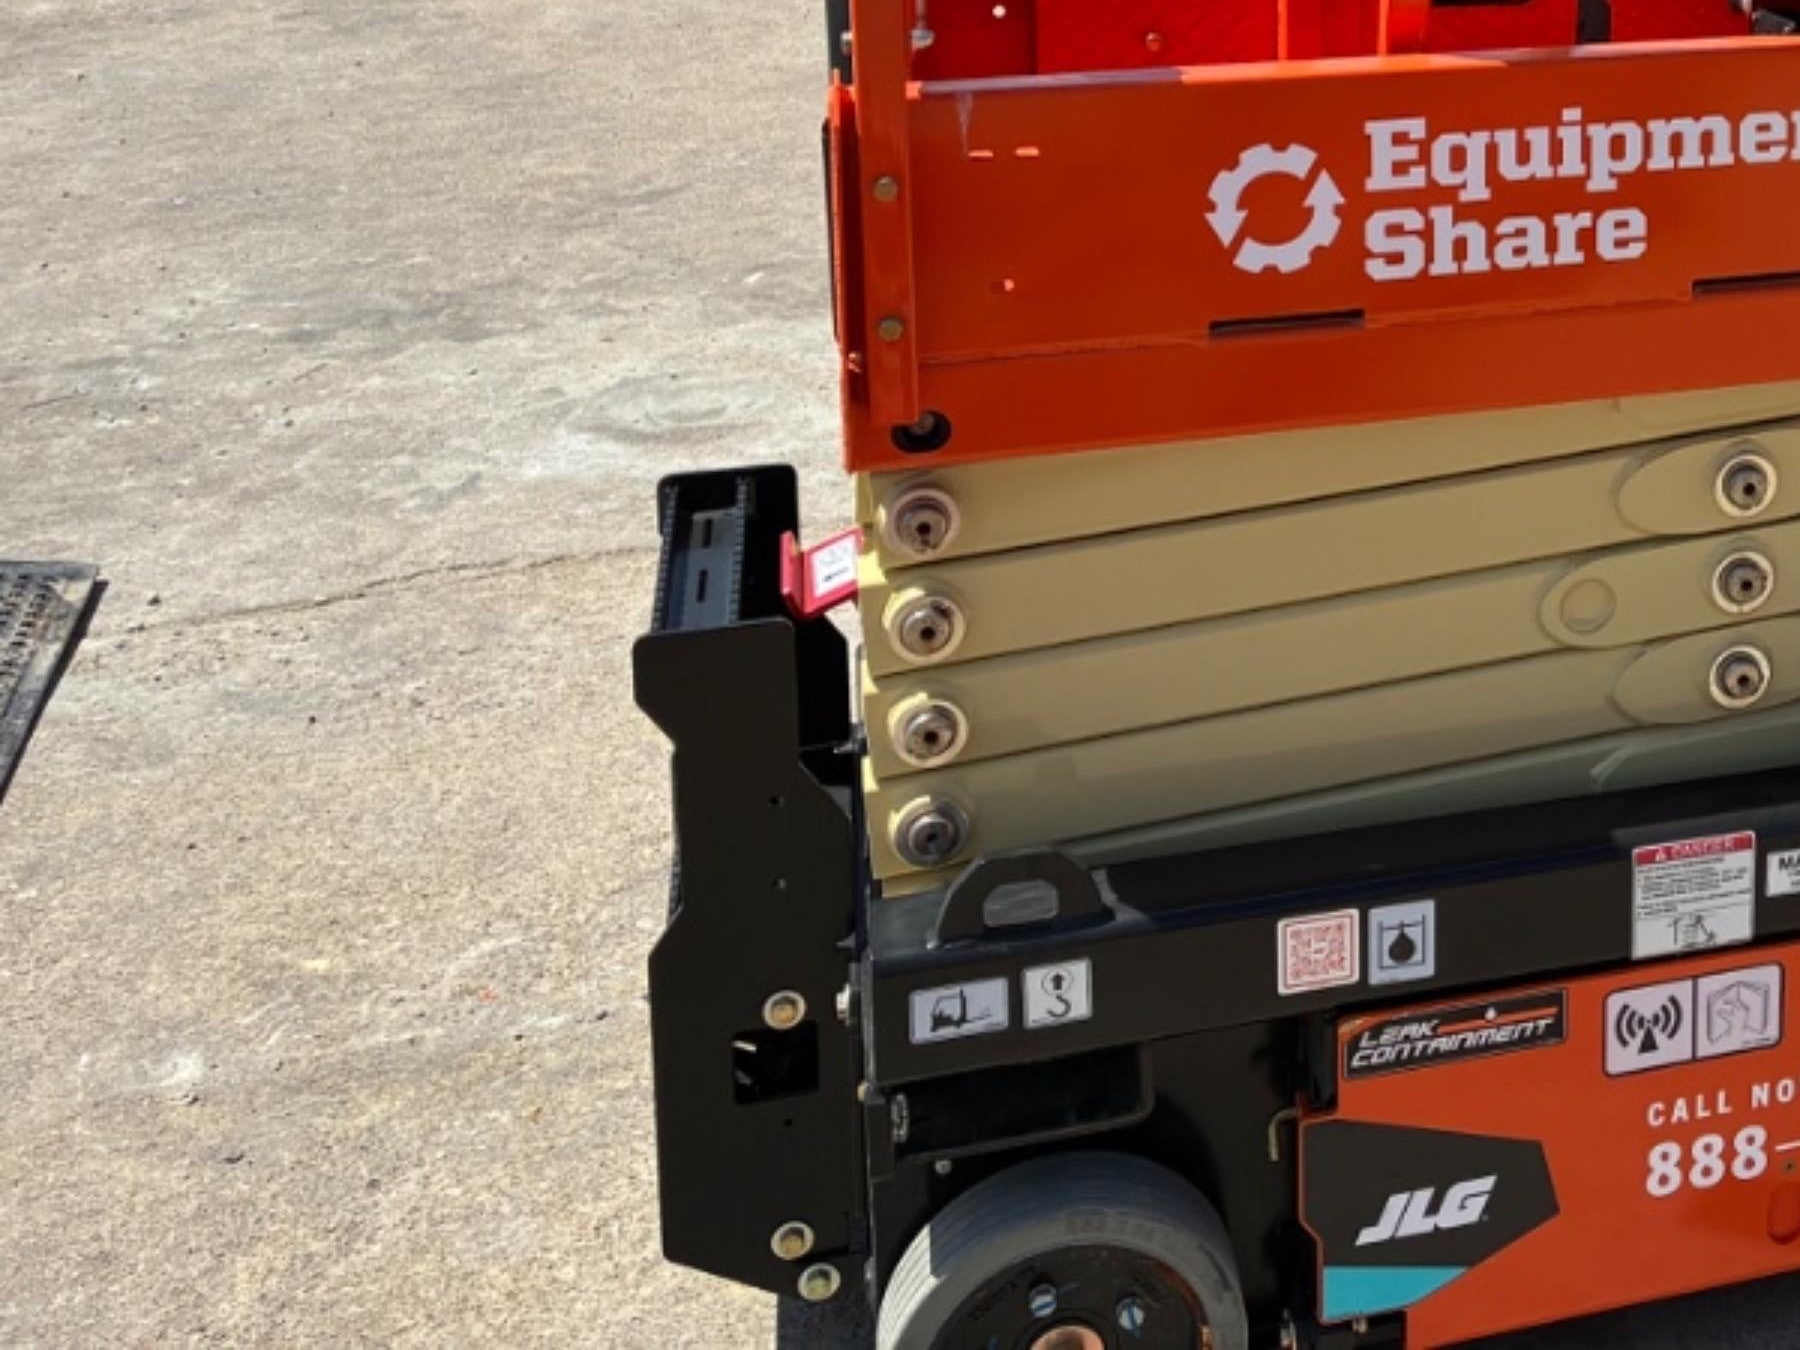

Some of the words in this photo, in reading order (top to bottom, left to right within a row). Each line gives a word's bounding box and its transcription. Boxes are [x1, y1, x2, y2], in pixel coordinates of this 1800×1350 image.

[1364, 203, 1648, 282] Share
[1351, 1017, 1555, 1068] CONTAINMENT
[1359, 1019, 1439, 1049] LEAK
[1647, 1092, 1735, 1126] CALL
[1354, 1174, 1497, 1247] JLG
